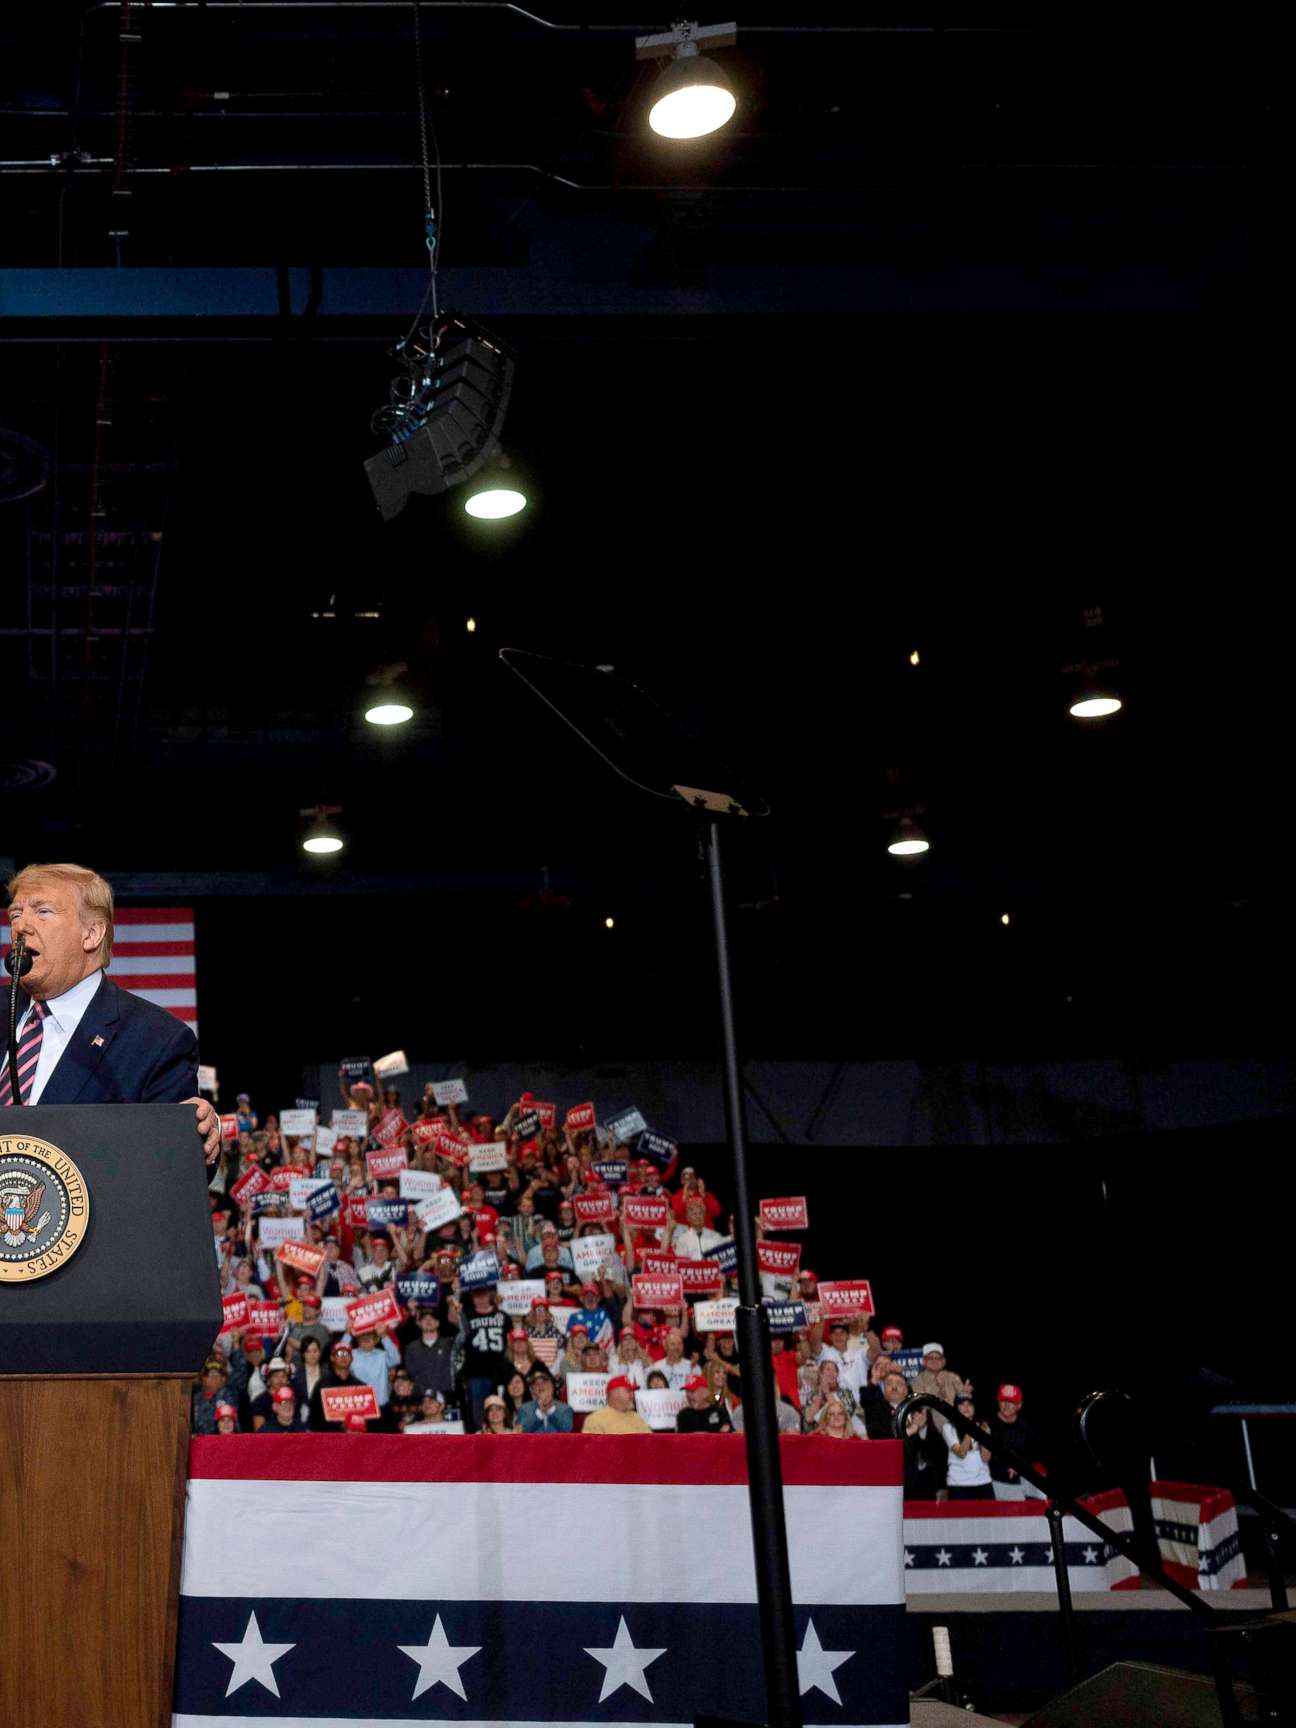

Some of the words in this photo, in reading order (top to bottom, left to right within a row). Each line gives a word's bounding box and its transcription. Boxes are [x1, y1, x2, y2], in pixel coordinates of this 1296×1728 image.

[645, 1133, 674, 1148] TRUMP
[16, 1141, 31, 1151] OF
[33, 1144, 52, 1159] THE
[54, 1158, 84, 1217] UNITED
[369, 1205, 406, 1214] TRUMP
[577, 1201, 611, 1209] TRUMP
[627, 1205, 666, 1213] TRUMP
[764, 1206, 802, 1214] TRUMP
[27, 1230, 78, 1274] STATES
[758, 1248, 798, 1260] TRUMP
[680, 1268, 718, 1276] TRUMP
[637, 1282, 680, 1290] TRUMP
[825, 1290, 867, 1299] TRUMP
[350, 1299, 392, 1318] TRUMP
[470, 1312, 504, 1328] TRUMP
[472, 1328, 503, 1352] 45
[326, 1394, 373, 1403] TRUMP
